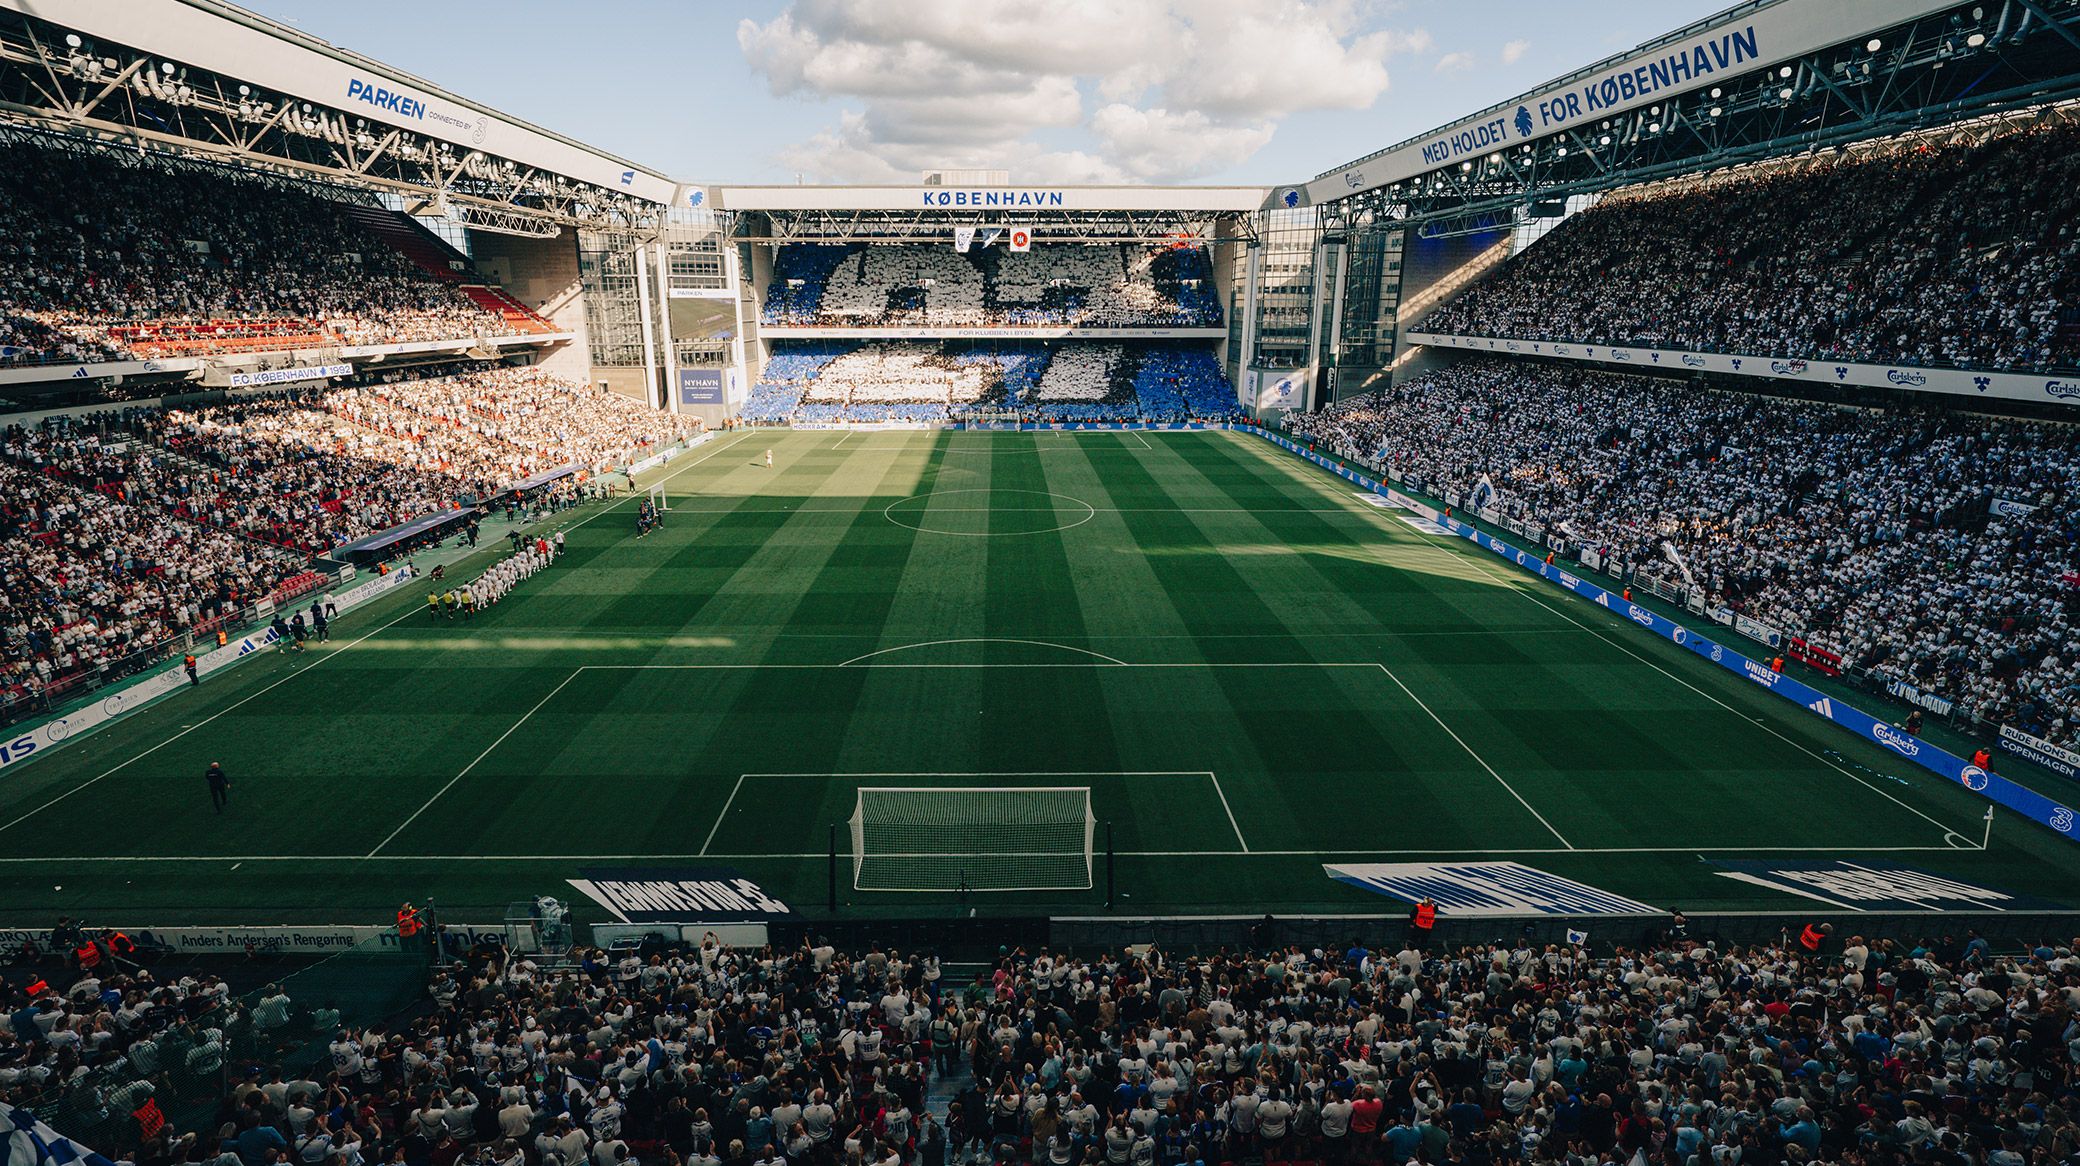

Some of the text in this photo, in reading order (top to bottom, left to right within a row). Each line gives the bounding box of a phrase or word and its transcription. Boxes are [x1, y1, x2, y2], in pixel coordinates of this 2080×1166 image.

[1539, 25, 1759, 126] FOR KØBENHAVN
[347, 79, 426, 120] PARKEN
[429, 111, 463, 128] CONNECTED
[1422, 118, 1507, 164] MED HOLDET
[923, 191, 1063, 206] KØBENHAVN
[1682, 354, 1706, 367] Carlsberg
[232, 365, 351, 385] F.C. KØBENHAVN 1992
[1887, 370, 1926, 386] Carlsberg
[1629, 605, 1653, 625] Carlsberg
[1745, 660, 1780, 684] UNIBET
[1873, 723, 1919, 755] Carlsberg
[2005, 727, 2067, 759] RUDE LIONS
[2001, 739, 2075, 777] COPENHAGEN
[182, 933, 353, 948] Anders Andersen's Rengøring
